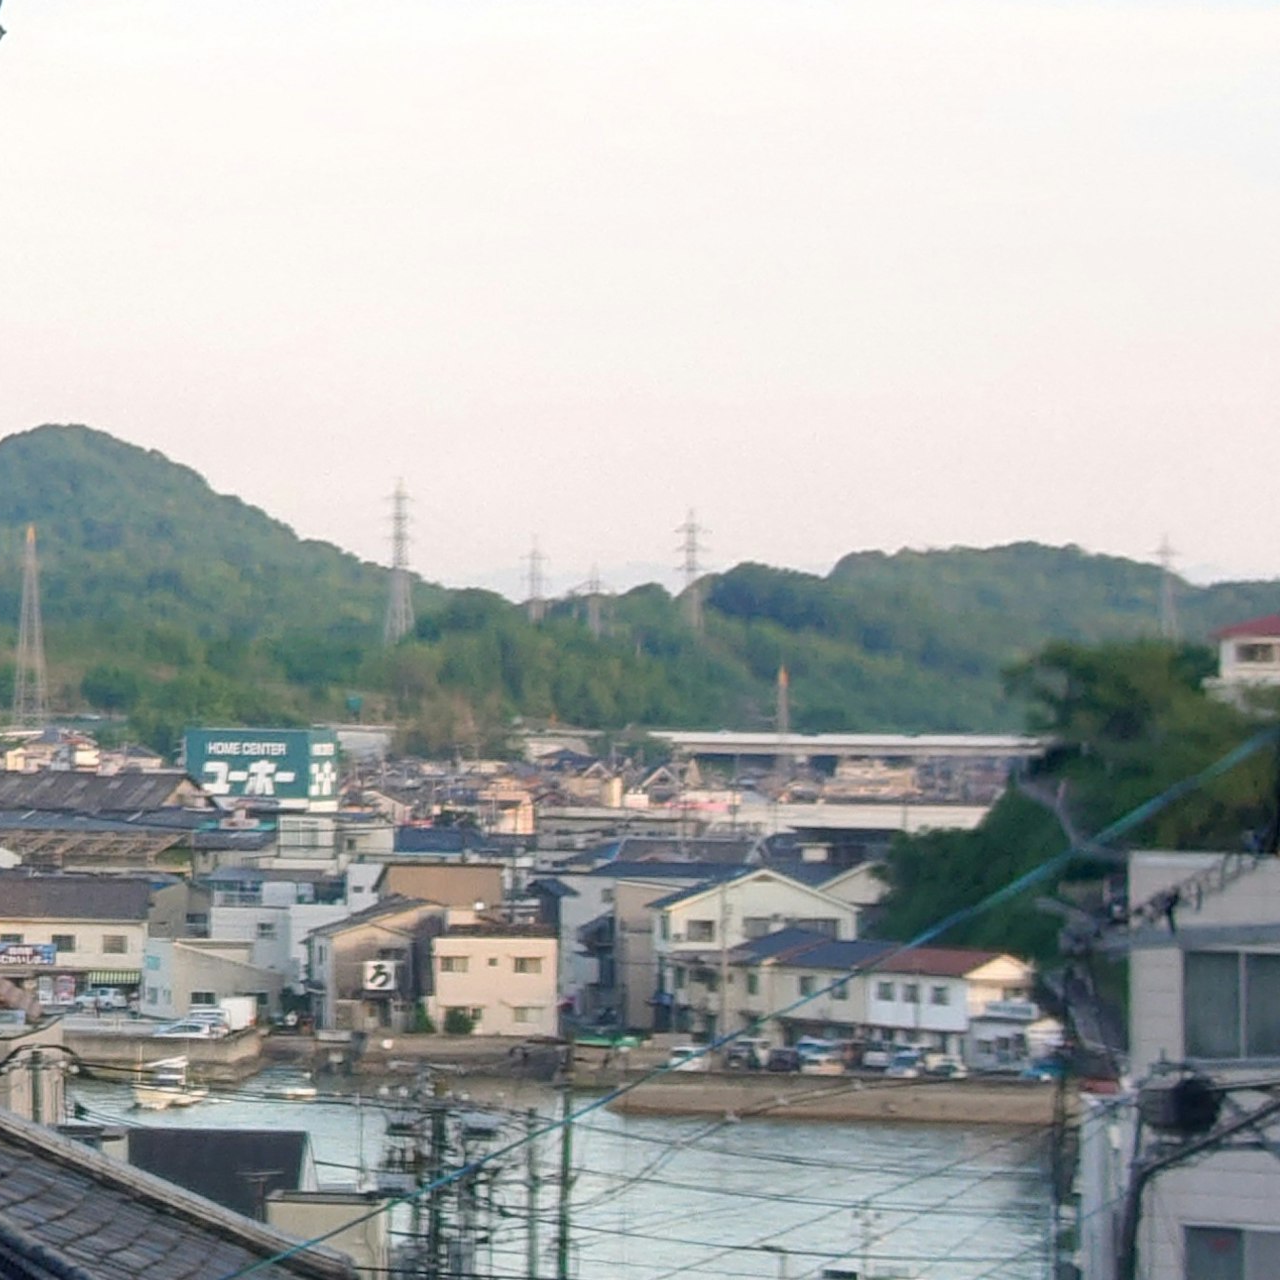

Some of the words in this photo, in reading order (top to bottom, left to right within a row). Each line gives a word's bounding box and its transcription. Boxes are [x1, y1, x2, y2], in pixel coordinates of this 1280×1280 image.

[208, 742, 240, 755] HOME
[242, 742, 286, 755] CENTER
[203, 760, 295, 795] ユーホー
